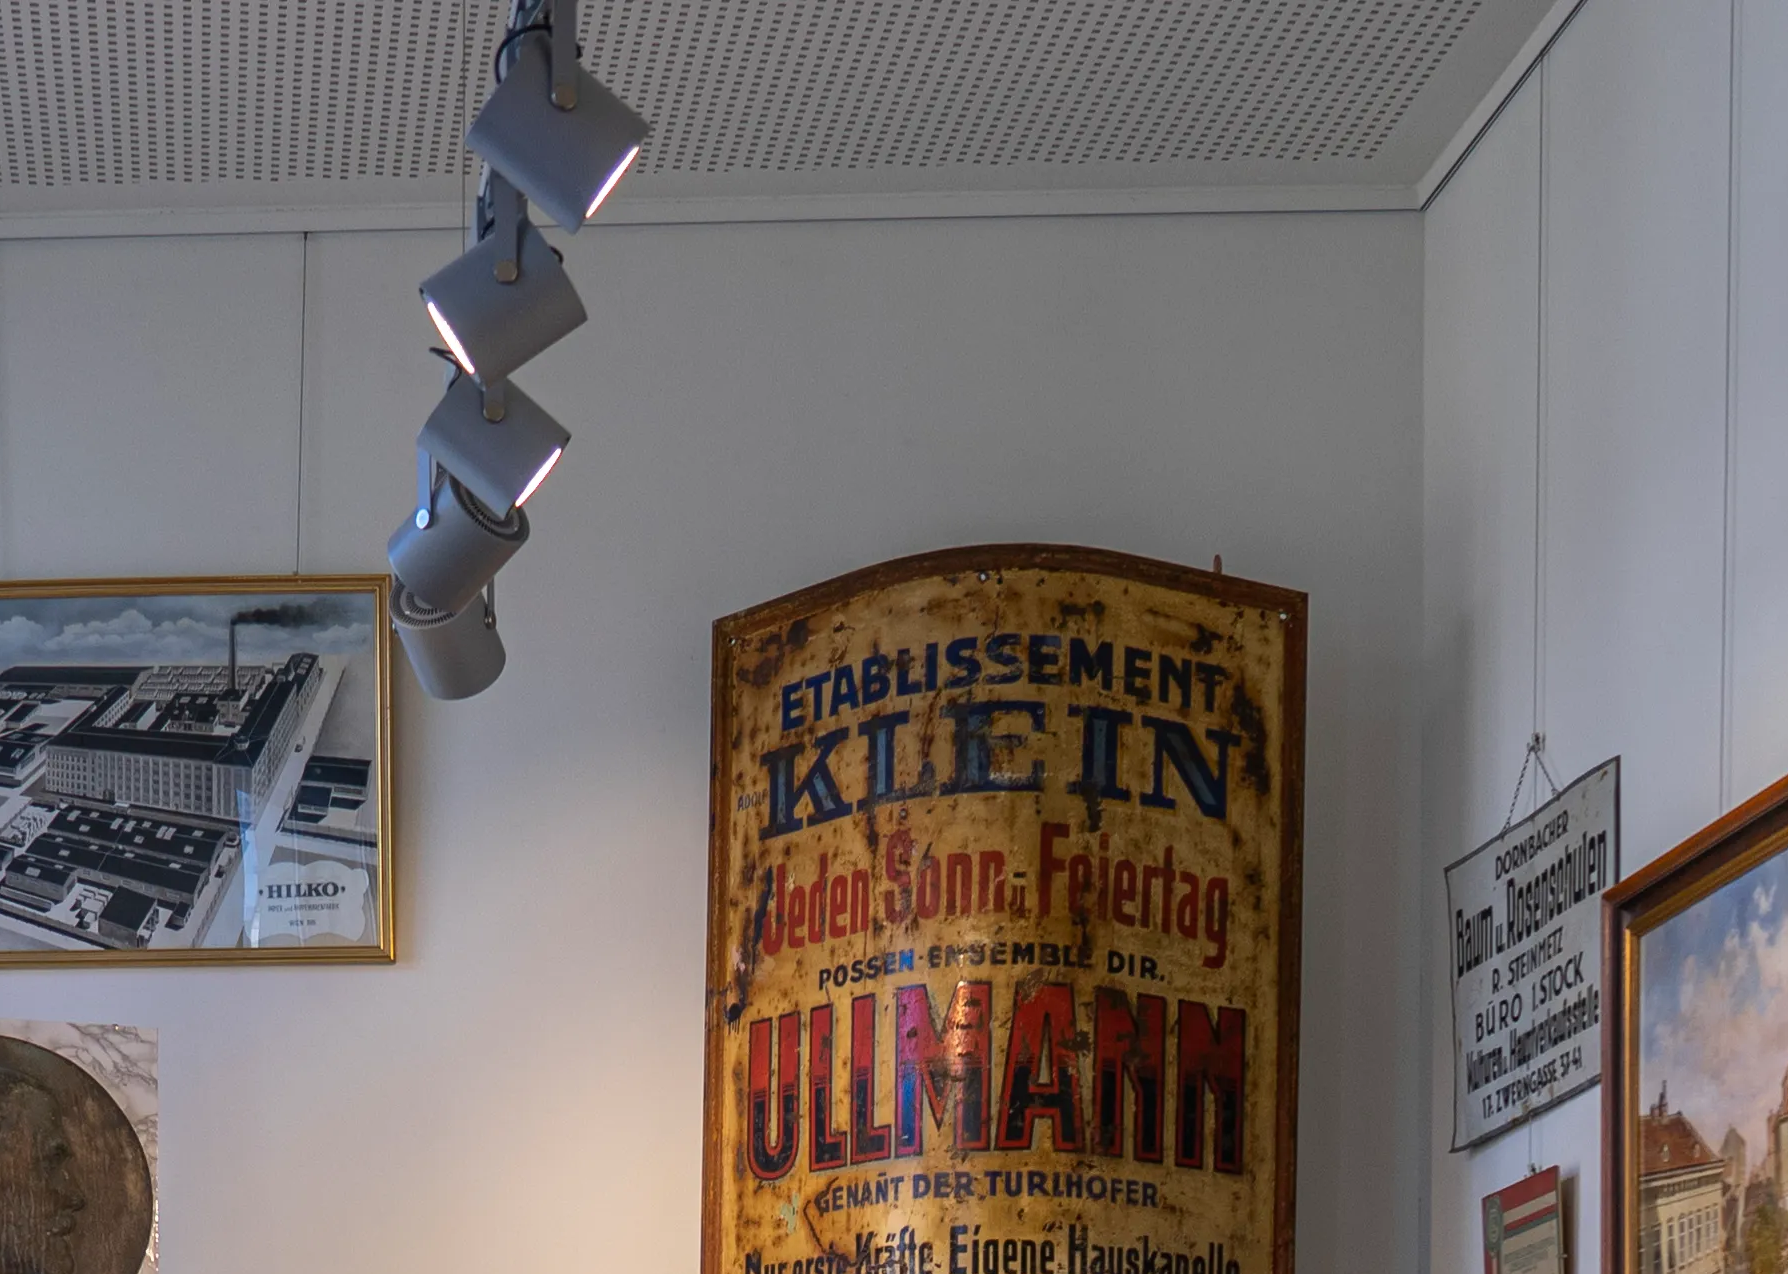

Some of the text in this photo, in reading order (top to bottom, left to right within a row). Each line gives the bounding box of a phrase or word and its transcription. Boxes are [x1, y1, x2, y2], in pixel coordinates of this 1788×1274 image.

[781, 634, 1227, 731] ETABLISSEMENT
[759, 701, 1242, 839] KLEIN
[1495, 810, 1569, 881] DORNBACHER
[267, 882, 339, 899] HILKO
[763, 852, 870, 956] Jeden
[1038, 823, 1229, 969] Feiertag
[1455, 905, 1494, 979] Baum
[1506, 829, 1607, 949] Rosenschulen
[818, 943, 1166, 990] POSSEN-ENSEMBLE DIR.
[1492, 925, 1564, 994] R. STEINMETZ
[747, 981, 1246, 1180] ULLMANN
[913, 1171, 975, 1199] DER
